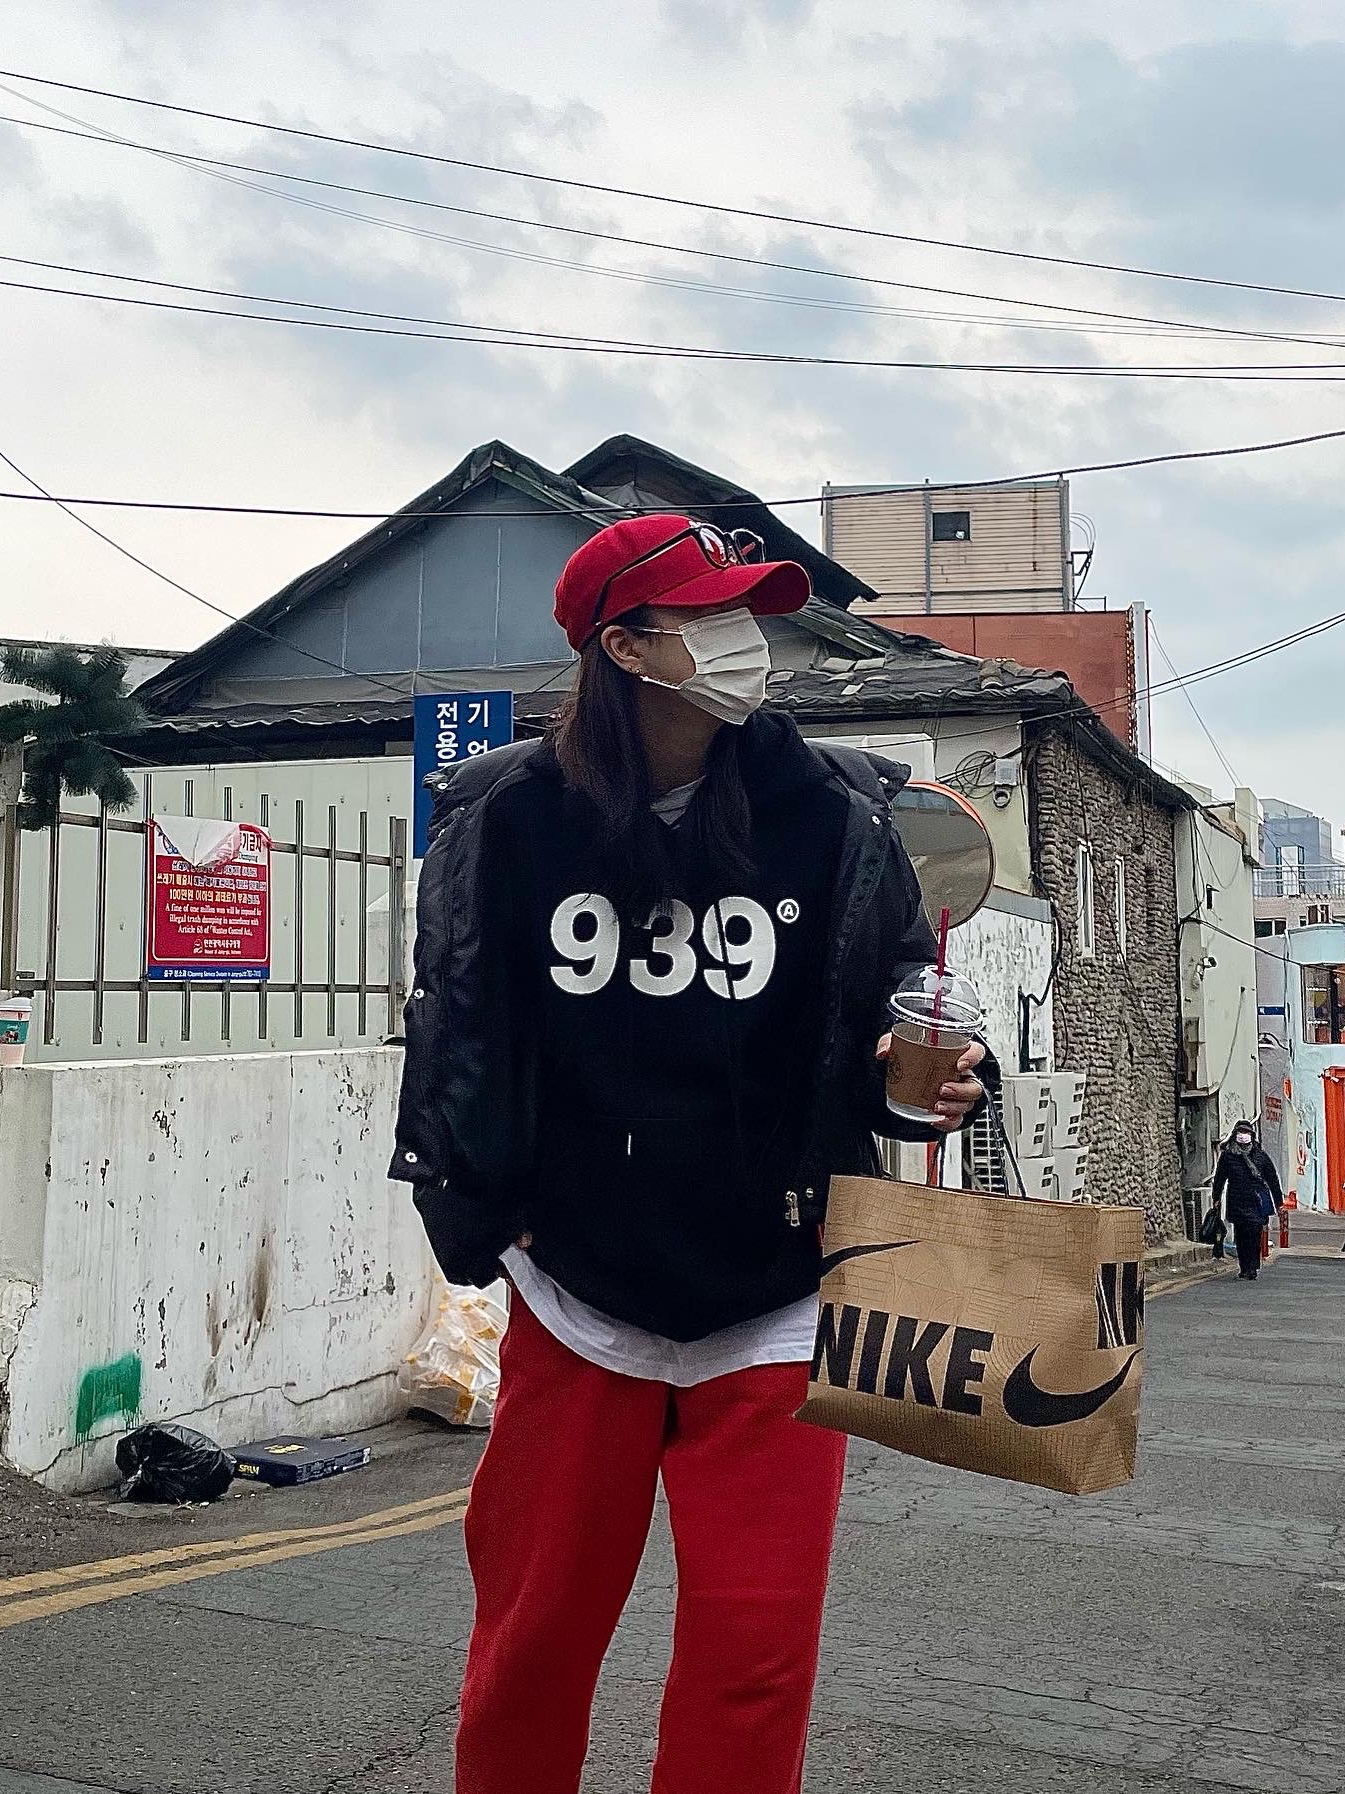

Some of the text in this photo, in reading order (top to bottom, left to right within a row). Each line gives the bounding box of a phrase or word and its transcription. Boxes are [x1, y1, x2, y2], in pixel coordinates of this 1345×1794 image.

[240, 832, 262, 853] 기금지
[157, 873, 175, 885] 쓰레기
[169, 888, 194, 901] 100만원
[195, 889, 214, 902] 이하의
[215, 891, 237, 904] 과태료가
[165, 903, 170, 912] A
[171, 903, 182, 912] fine
[183, 904, 190, 913] of
[169, 913, 186, 924] illegal
[187, 914, 201, 923] trash
[177, 925, 196, 933] Article
[203, 925, 209, 934] of
[550, 893, 777, 1001] 939
[808, 1301, 995, 1417] NIKE
